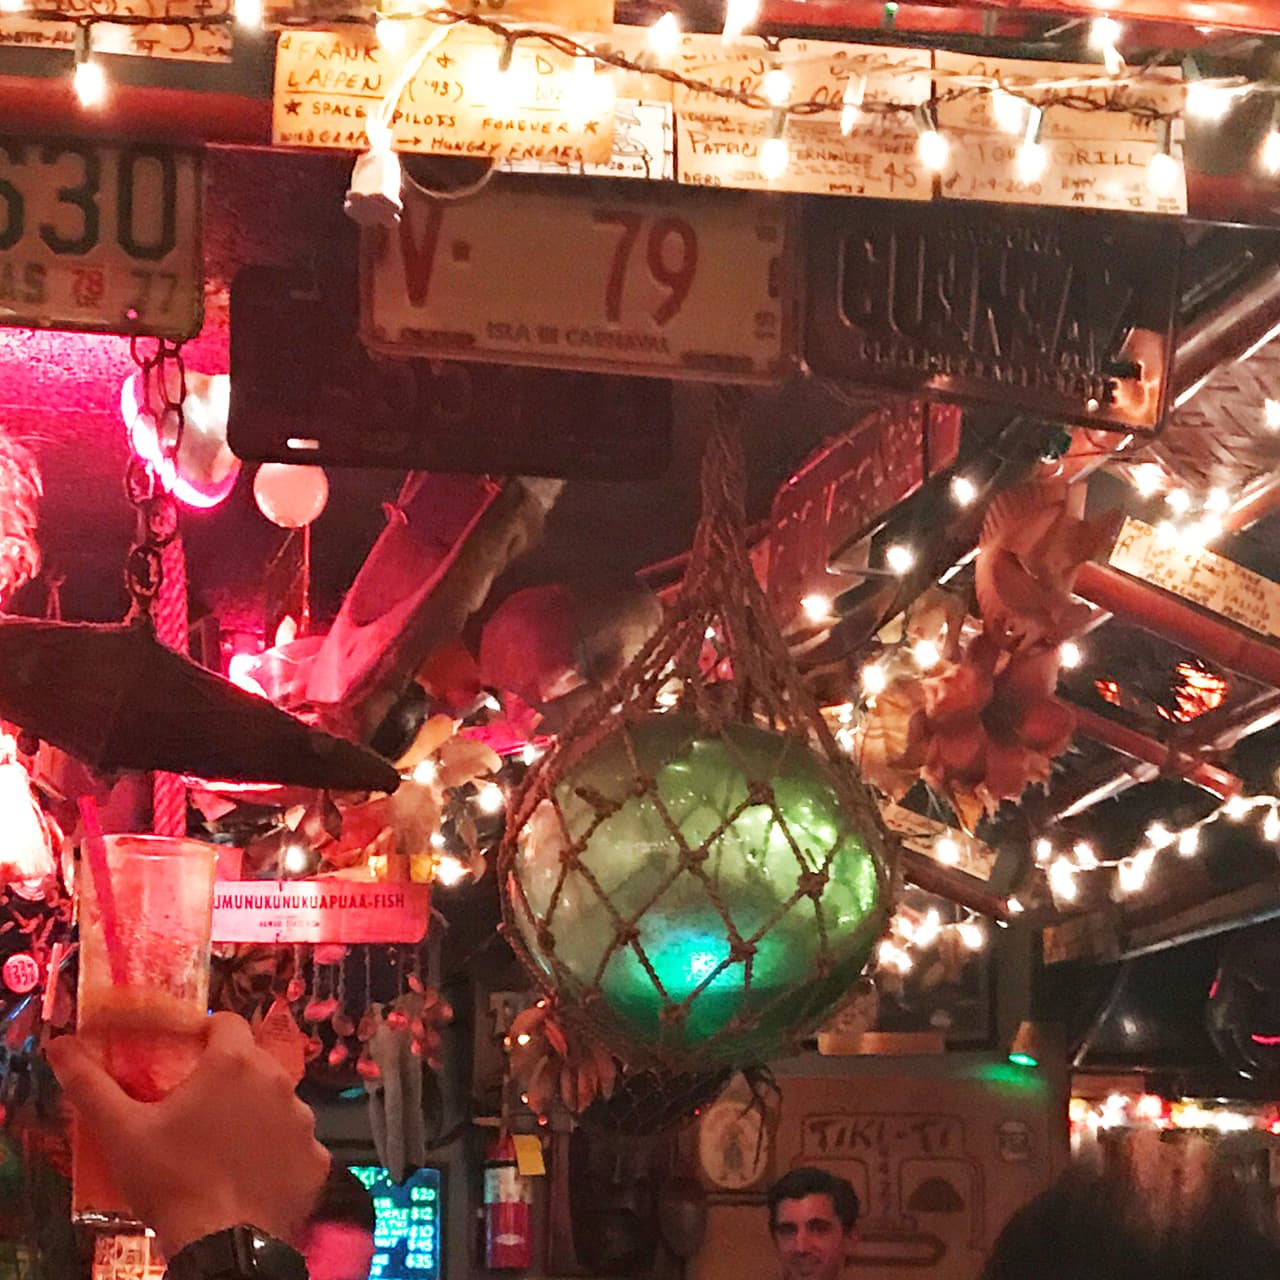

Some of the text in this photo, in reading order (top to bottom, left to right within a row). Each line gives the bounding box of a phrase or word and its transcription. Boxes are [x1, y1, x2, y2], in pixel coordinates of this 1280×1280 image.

[312, 100, 368, 119] SPACE
[392, 109, 456, 128] PILOTS
[431, 136, 502, 157] HUNGRY
[592, 208, 699, 328] 79
